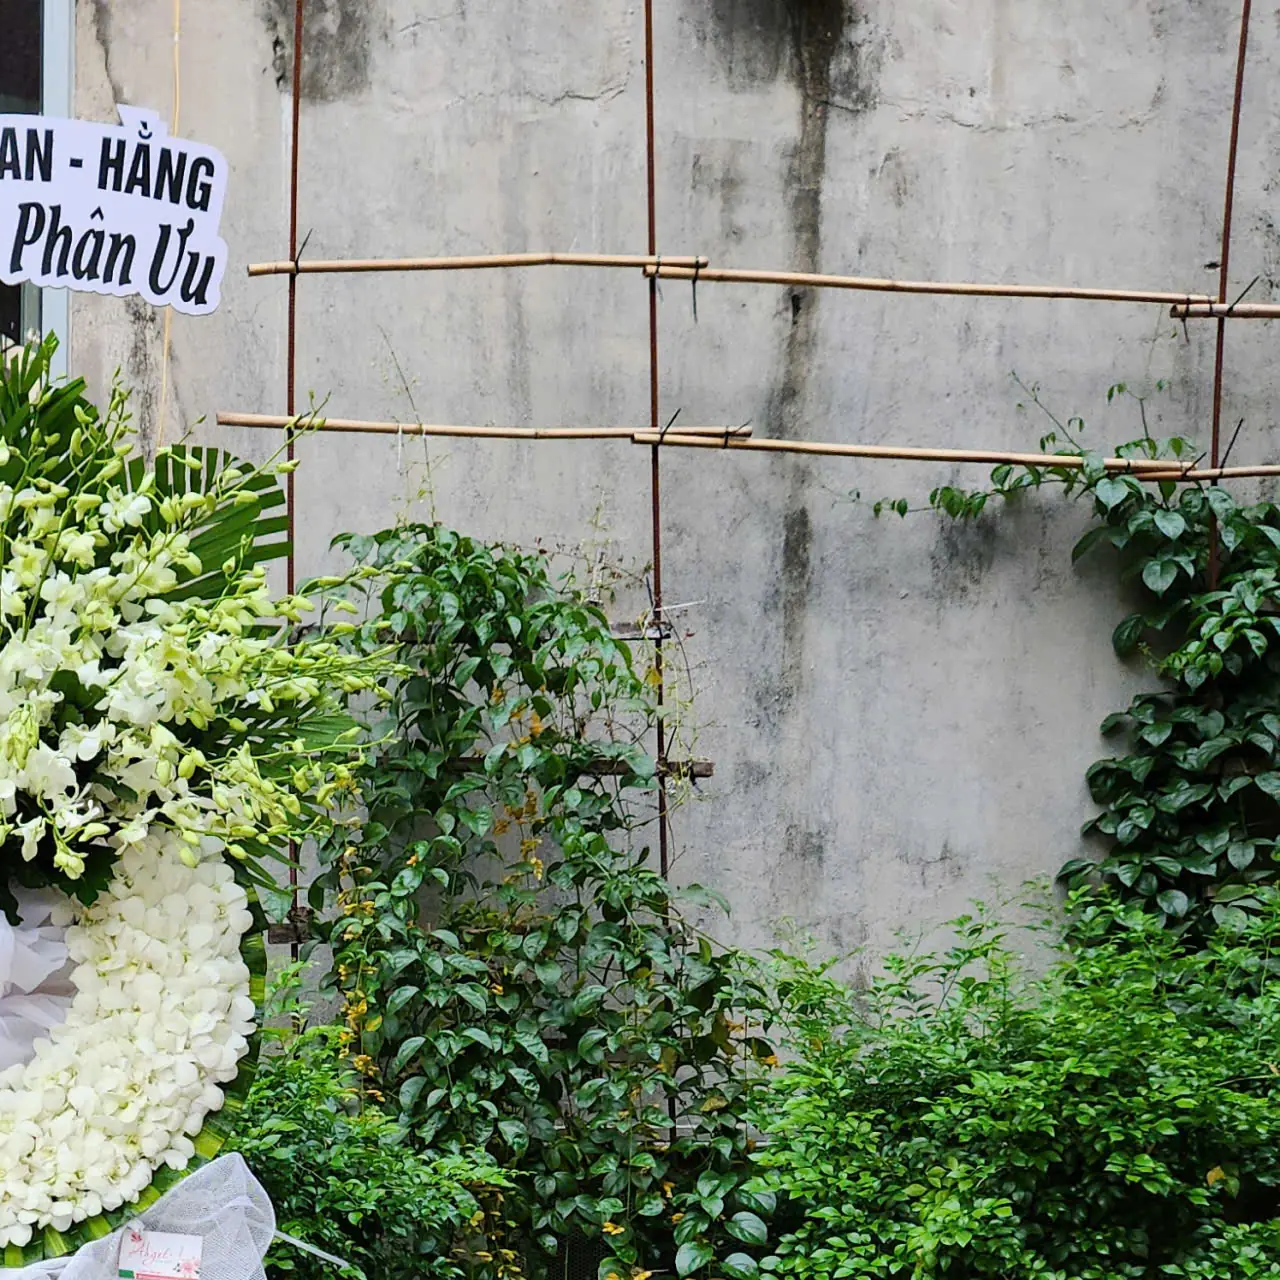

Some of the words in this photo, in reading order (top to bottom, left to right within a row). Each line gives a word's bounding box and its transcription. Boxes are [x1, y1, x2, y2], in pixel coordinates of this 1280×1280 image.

[97, 120, 216, 213] HẰNG
[9, 202, 137, 286] Phân
[148, 217, 216, 305] Ưu
